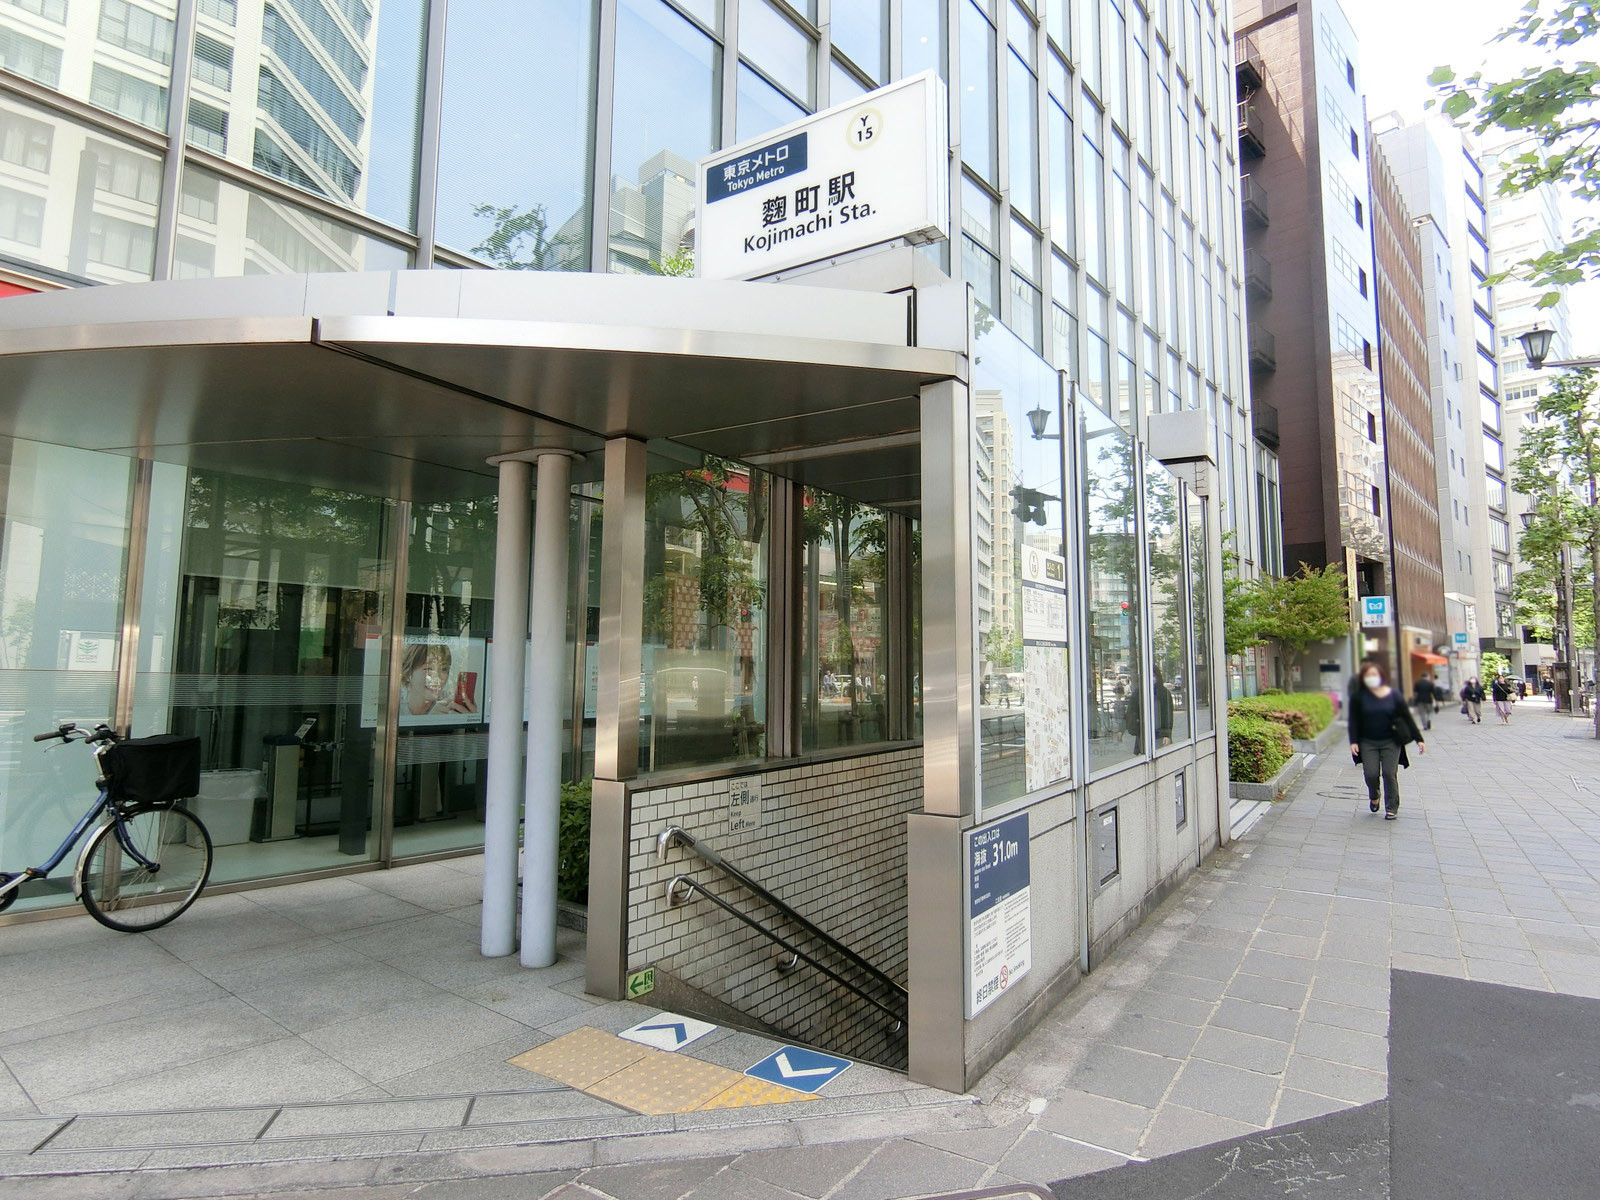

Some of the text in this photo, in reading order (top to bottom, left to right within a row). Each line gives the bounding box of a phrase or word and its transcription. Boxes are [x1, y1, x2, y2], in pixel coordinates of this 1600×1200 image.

[857, 127, 873, 142] 15
[860, 115, 869, 127] Y
[723, 145, 789, 182] 東京メトロ
[727, 164, 785, 192] Tokyo Metro
[744, 203, 876, 253] Kojimachi Sta.
[731, 818, 745, 831] Left
[974, 828, 1000, 847] この出入口は
[992, 840, 1018, 867] 31.0m
[976, 975, 999, 1005] 終日禁煙
